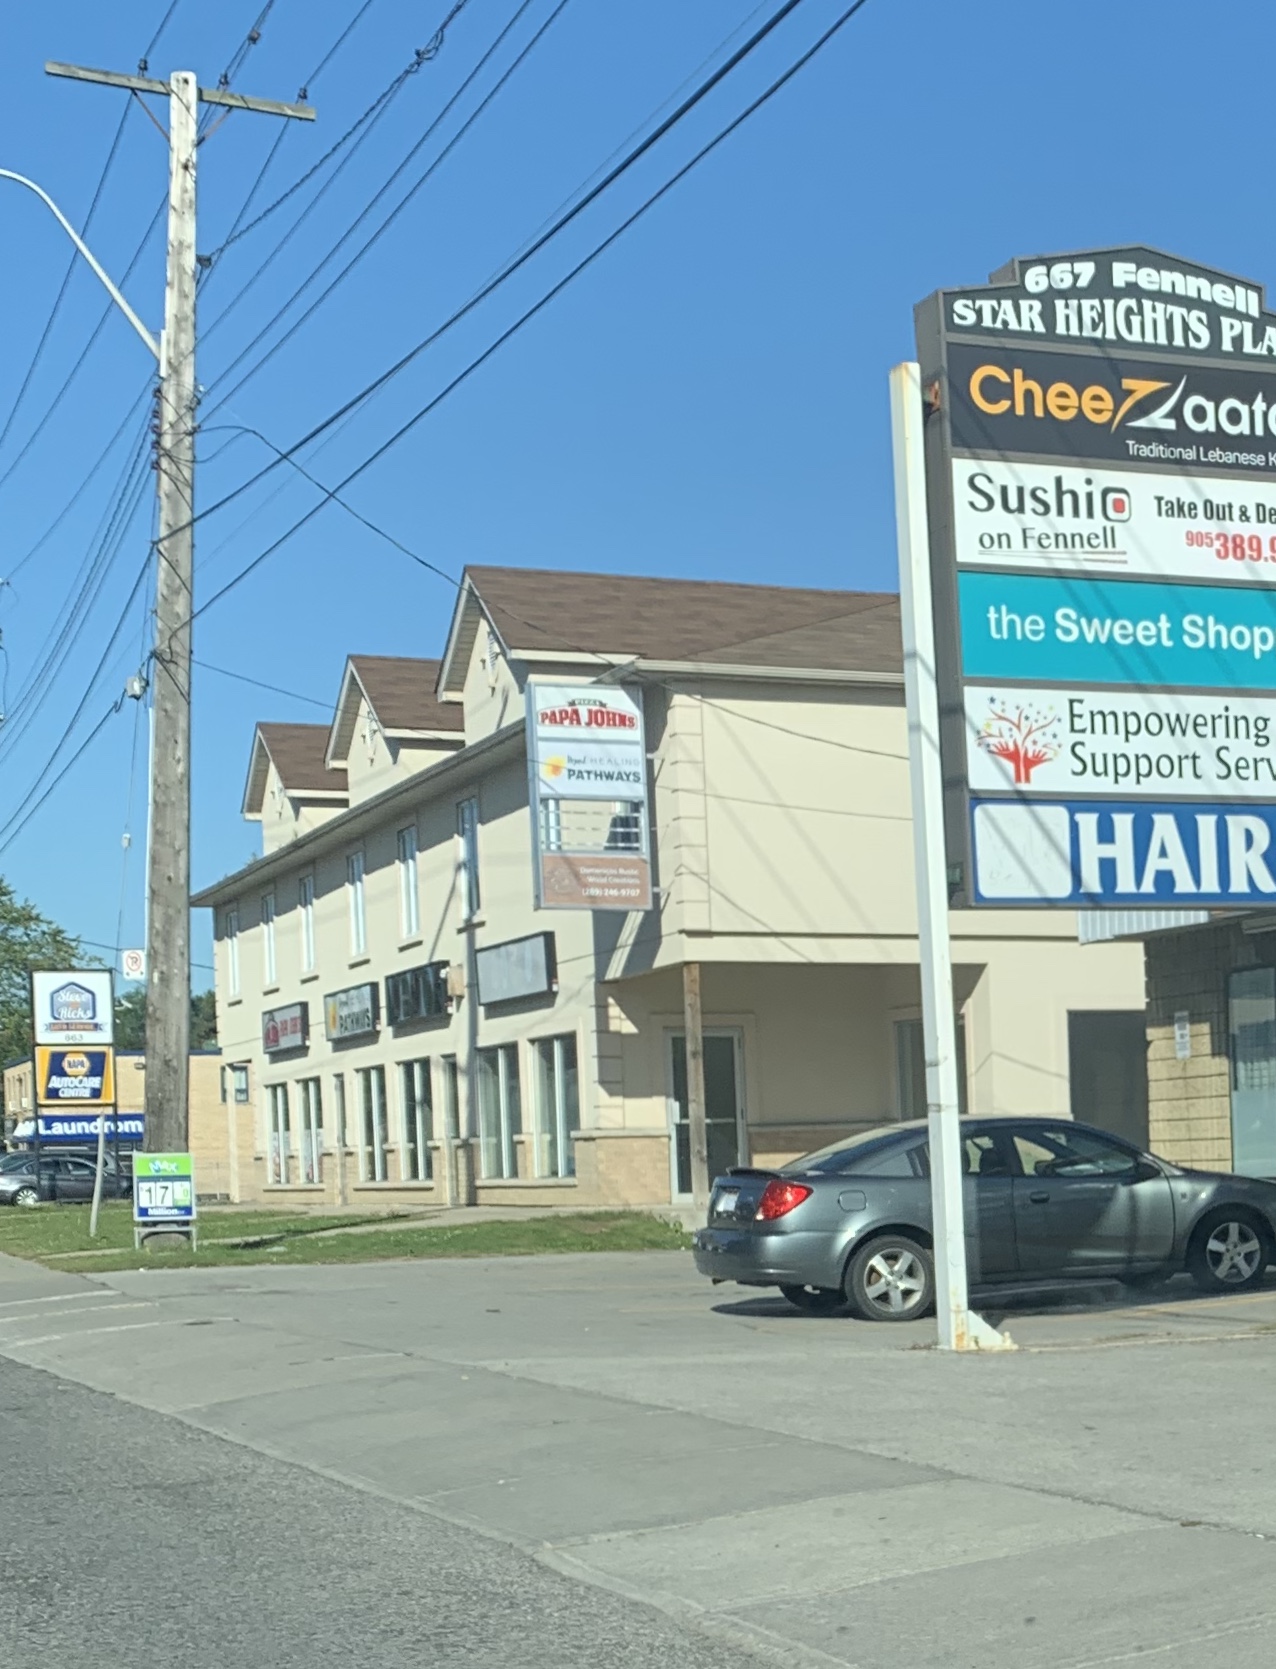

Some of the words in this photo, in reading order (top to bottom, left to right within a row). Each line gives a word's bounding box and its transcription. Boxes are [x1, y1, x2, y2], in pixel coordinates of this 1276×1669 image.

[1024, 261, 1096, 294] 667
[1112, 261, 1260, 317] Fennell
[952, 299, 1047, 335] STAR
[1055, 297, 1211, 351] HEIGHTS
[1126, 440, 1198, 462] Traditional
[1200, 446, 1266, 468] Lebanese
[967, 472, 1095, 520] Sushi
[1154, 495, 1198, 520] Take
[1203, 499, 1233, 522] Out
[1239, 505, 1251, 523] &
[979, 530, 1011, 551] on
[1022, 526, 1117, 550] Fennell
[986, 605, 1045, 641] the
[1054, 608, 1174, 648] Sweet
[540, 708, 582, 725] PAPA
[1068, 698, 1271, 747] Empowering
[567, 769, 641, 783] PATHWAYS
[1070, 742, 1202, 785] Support
[67, 1059, 85, 1068] NAPA
